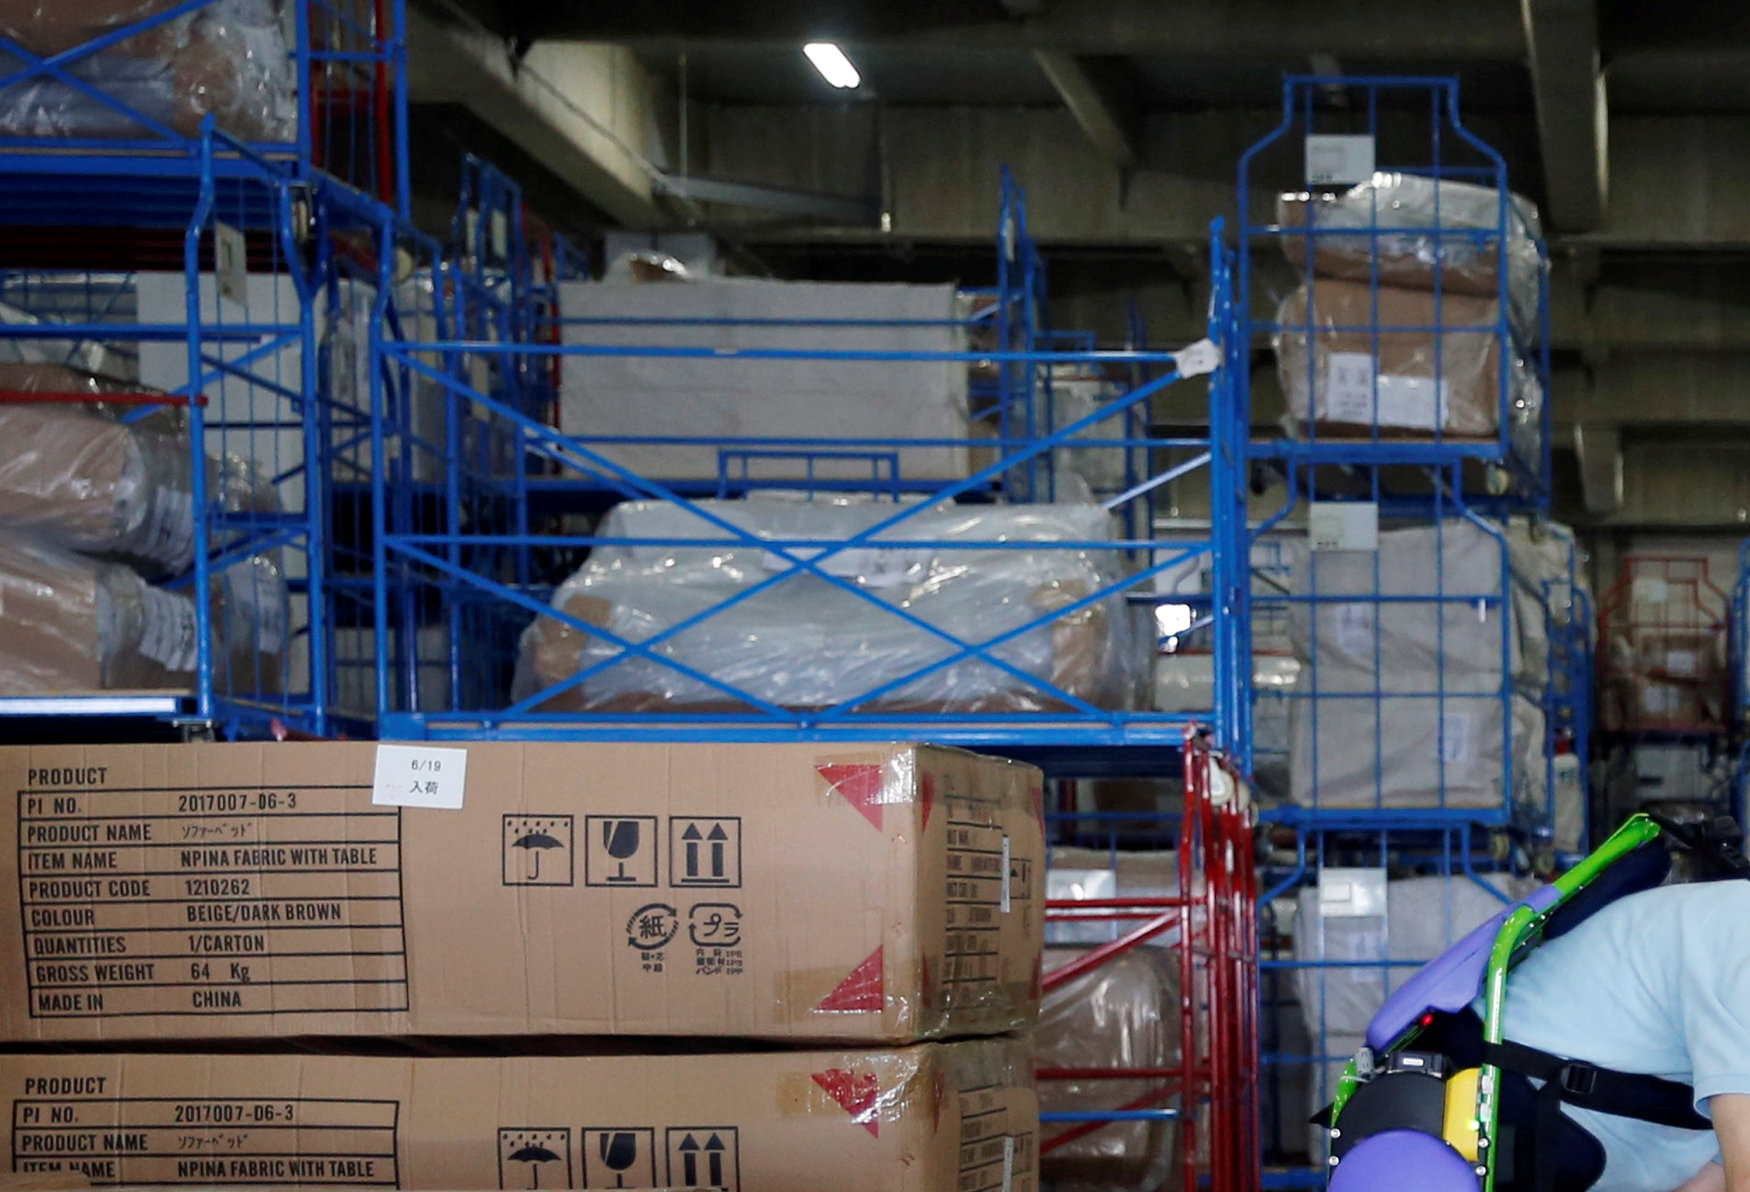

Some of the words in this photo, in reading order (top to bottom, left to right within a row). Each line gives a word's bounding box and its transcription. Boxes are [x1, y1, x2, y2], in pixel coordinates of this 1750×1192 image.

[411, 759, 442, 772] 6/19
[28, 766, 108, 786] PRODUCT
[410, 780, 439, 795] 入荷
[28, 797, 43, 815] PI
[54, 796, 82, 815] NO.
[27, 824, 100, 843] PRODUCT
[107, 823, 152, 841] NAME
[28, 852, 66, 870] ITEM
[72, 852, 118, 869] NAME
[181, 850, 230, 868] NPINA
[234, 849, 287, 867] FABRIC
[291, 848, 328, 866] WITH
[332, 847, 377, 865] TABLE
[29, 880, 102, 899] PRODUCT
[108, 880, 151, 897] CODE
[185, 878, 251, 896] 1210262
[31, 907, 96, 927] COLOUR
[187, 904, 282, 923] BEIGE/DARK
[286, 903, 342, 921] BROWN
[639, 915, 667, 939] 紙
[34, 936, 127, 956] QUANTITIES
[188, 934, 266, 953] 1/CARTON
[36, 964, 90, 984] GROSS
[95, 963, 155, 982] WEIGHT
[191, 963, 211, 980] 64
[230, 963, 251, 984] Kg
[38, 993, 83, 1012] MADE
[87, 993, 104, 1011] IN
[192, 991, 242, 1009] CHINA
[25, 1076, 107, 1095] PRODUCT
[23, 1106, 40, 1124] PI
[51, 1105, 79, 1123] NO.
[22, 1133, 97, 1153] PRODUCT
[103, 1133, 148, 1152] NAME
[178, 1161, 227, 1178] NPINA
[231, 1160, 284, 1177] FABRIC
[289, 1160, 325, 1177] WITH
[329, 1160, 374, 1178] TABLE
